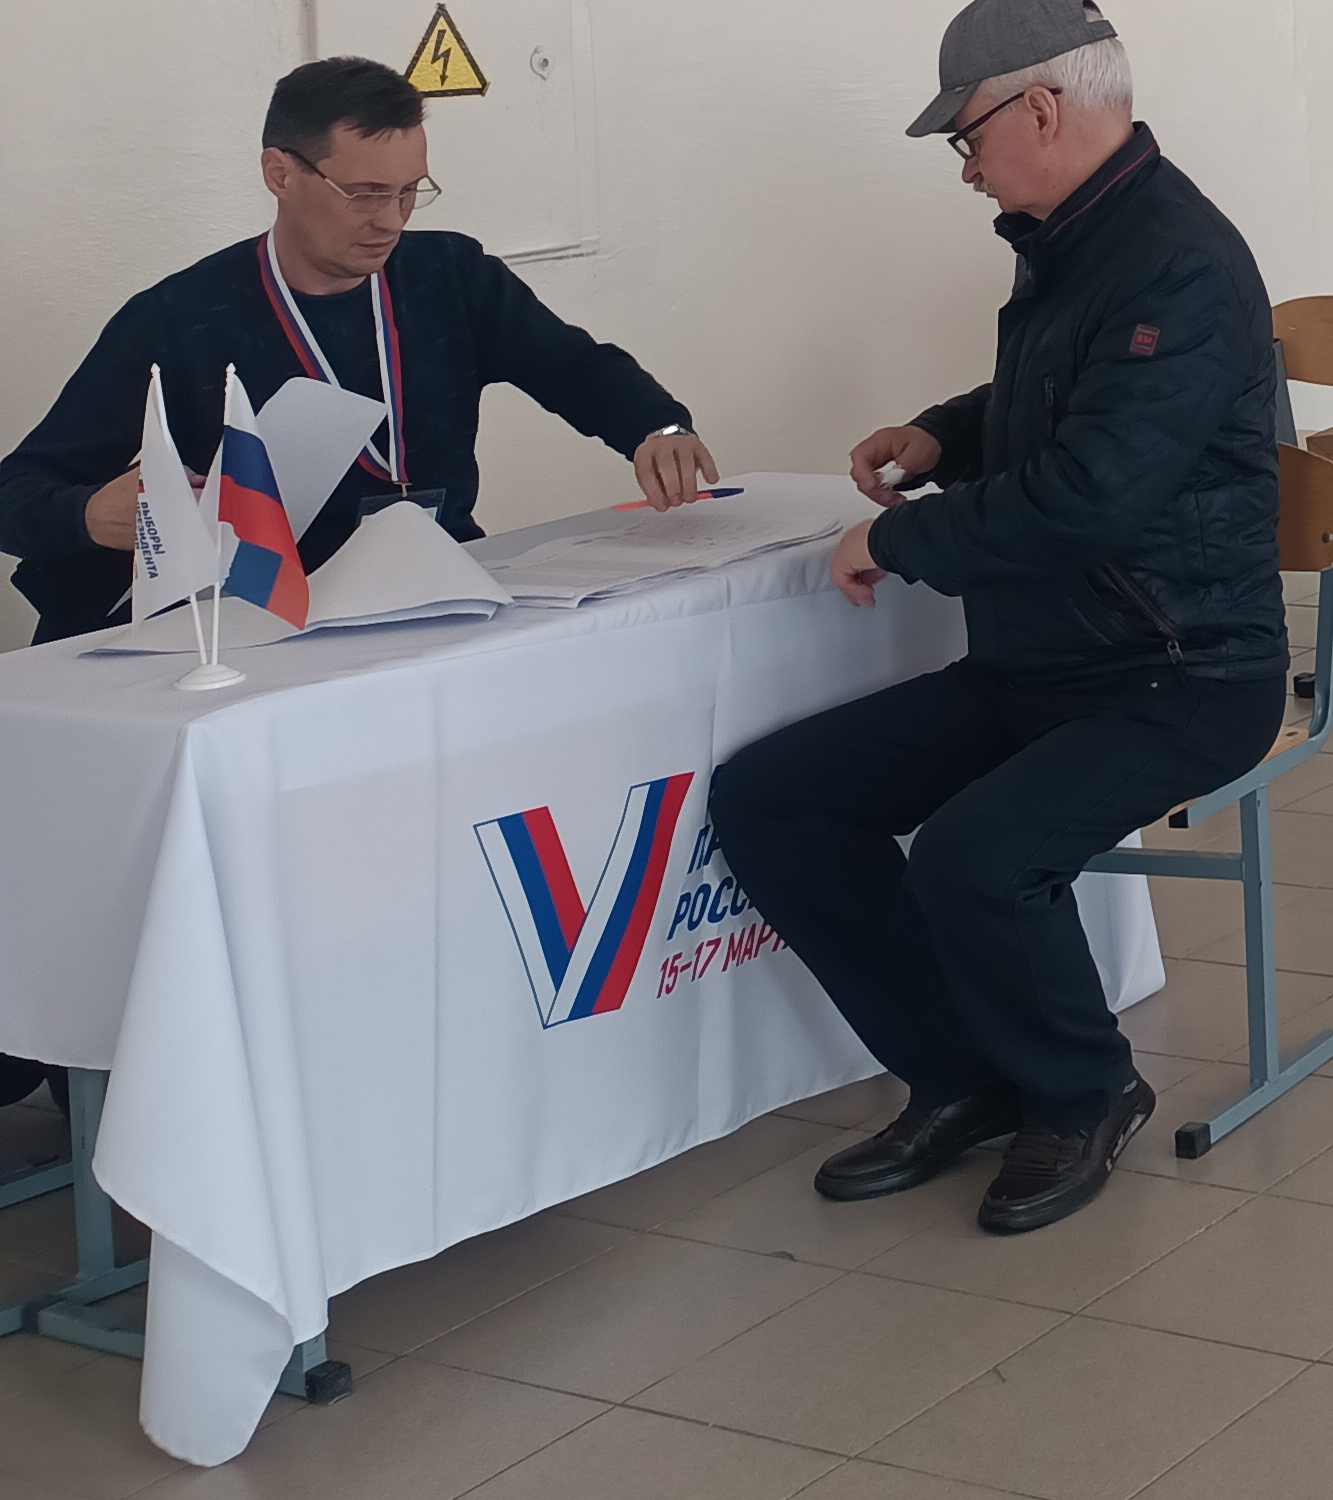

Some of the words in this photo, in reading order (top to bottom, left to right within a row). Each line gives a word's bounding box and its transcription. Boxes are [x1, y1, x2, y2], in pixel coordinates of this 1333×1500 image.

[666, 876, 754, 942] РОСС
[656, 937, 722, 999] 15-17
[721, 923, 789, 973] МАР
